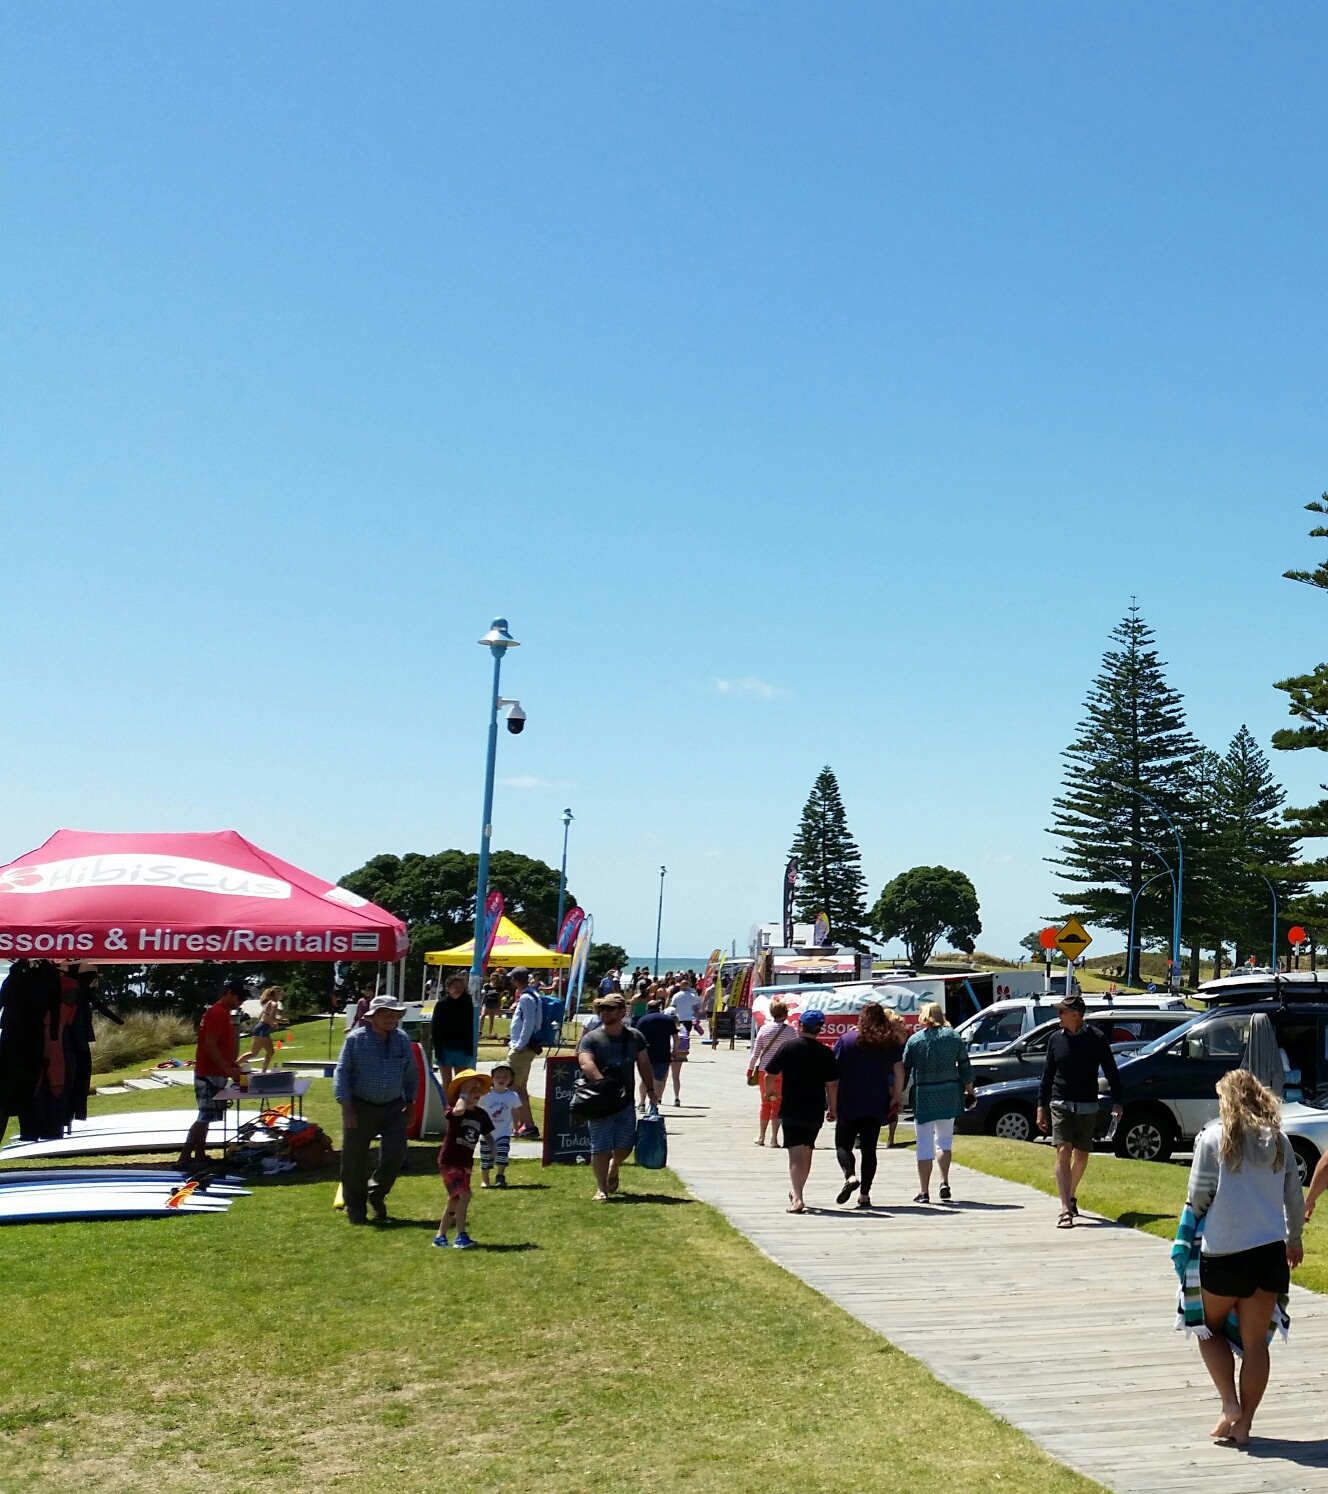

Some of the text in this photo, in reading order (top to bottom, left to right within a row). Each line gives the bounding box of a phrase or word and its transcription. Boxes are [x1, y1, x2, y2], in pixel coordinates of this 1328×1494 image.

[49, 857, 281, 895] Hibiscus
[0, 933, 94, 952] ssons
[104, 927, 128, 950] &
[138, 928, 348, 953] Hires/Rentals
[805, 990, 935, 1013] Hibiscus
